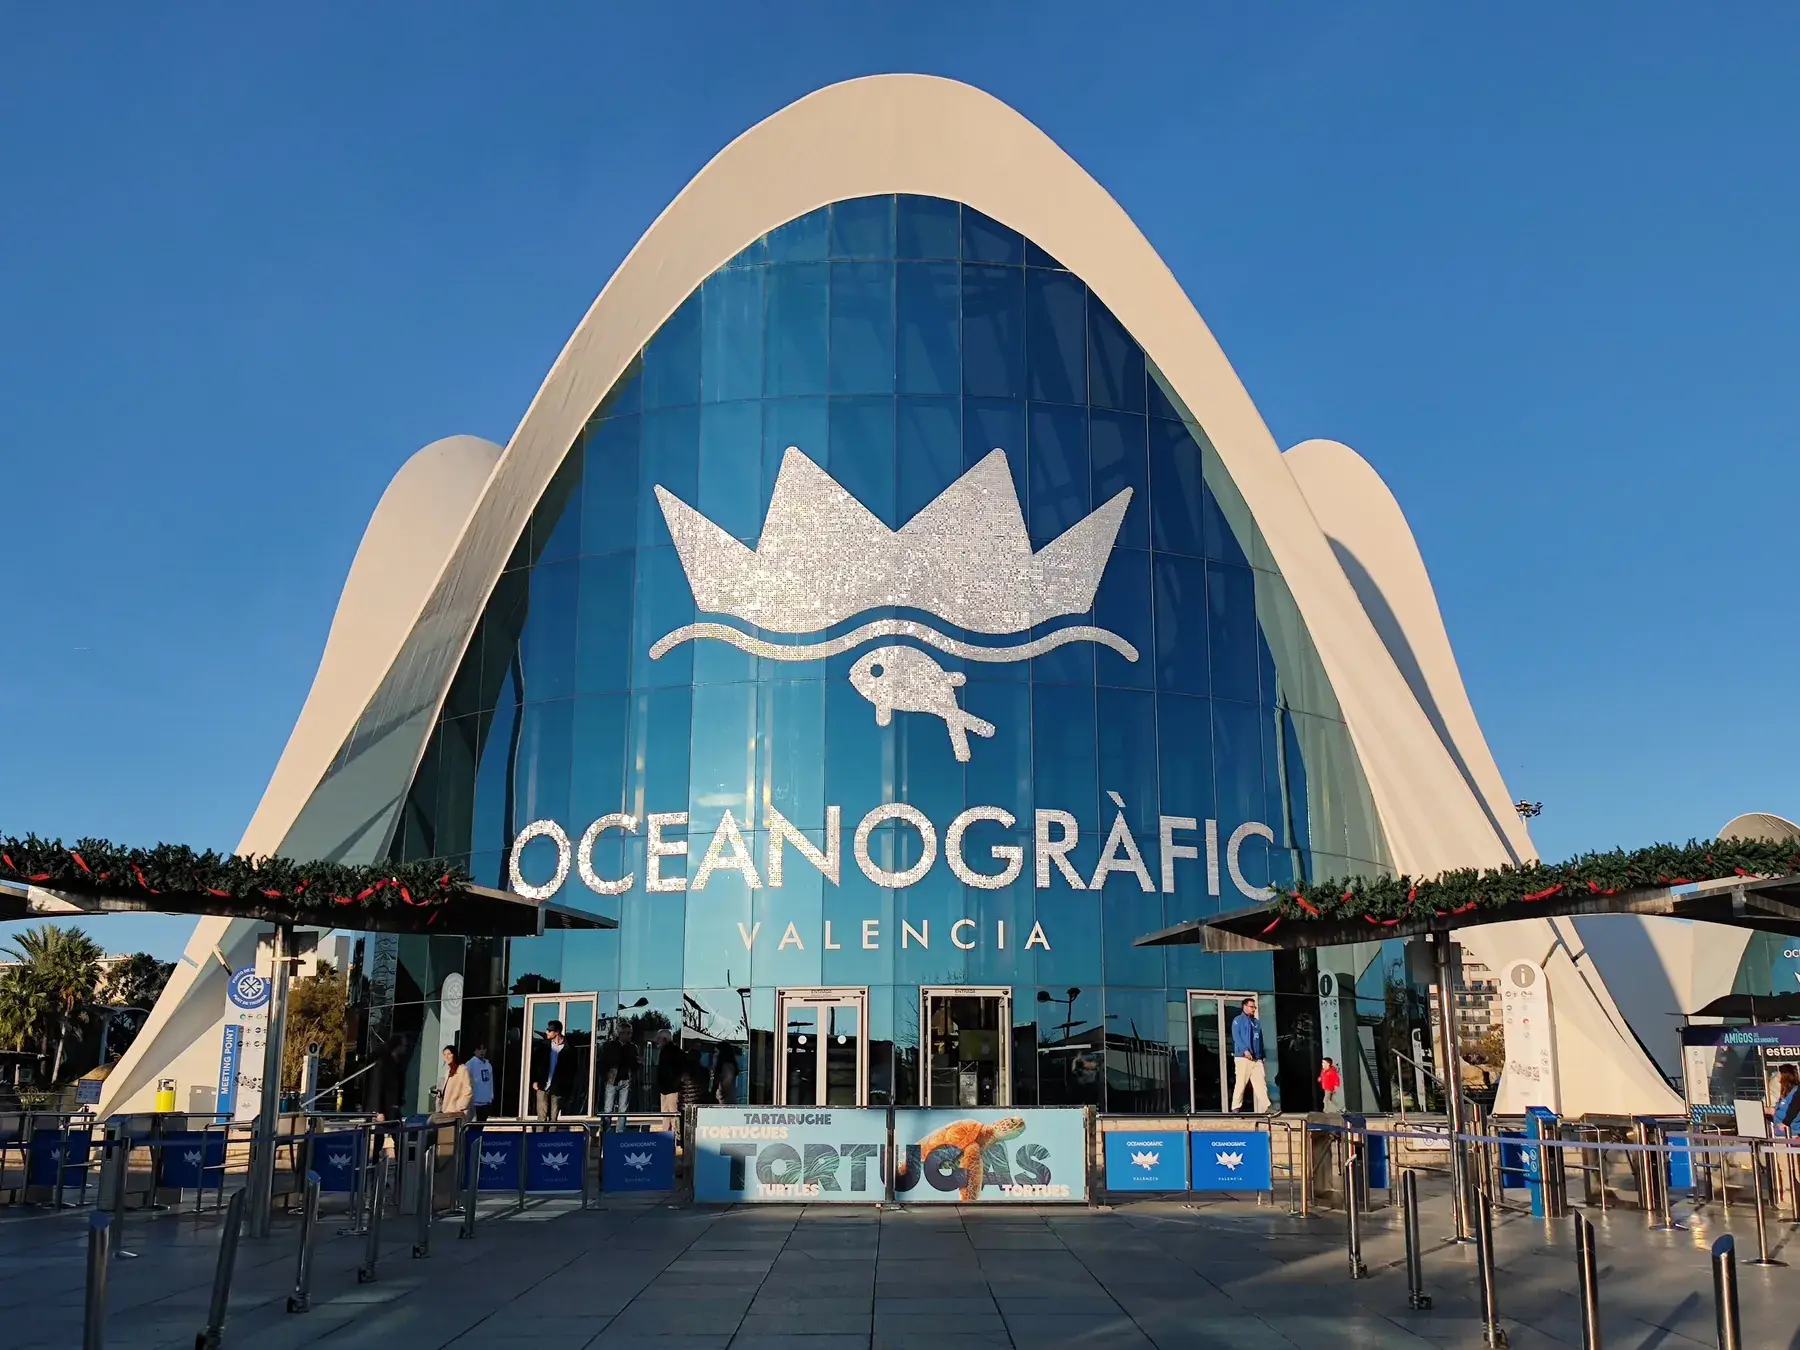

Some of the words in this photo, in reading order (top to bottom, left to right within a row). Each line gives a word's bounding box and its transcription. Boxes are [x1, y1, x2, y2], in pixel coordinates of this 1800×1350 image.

[509, 790, 1277, 901] OCEANOGRÀFIC
[737, 917, 1051, 952] VALENCIA
[224, 1028, 234, 1054] POINT
[1724, 1032, 1754, 1044] AMIGOS
[220, 1056, 231, 1095] MEETING
[744, 1113, 832, 1125] TARTARUGHE
[700, 1125, 789, 1140] TORTUGUES
[719, 1142, 1052, 1192] TORTUGAS
[757, 1183, 820, 1197] TURTLES
[1002, 1184, 1071, 1198] TORTUES
